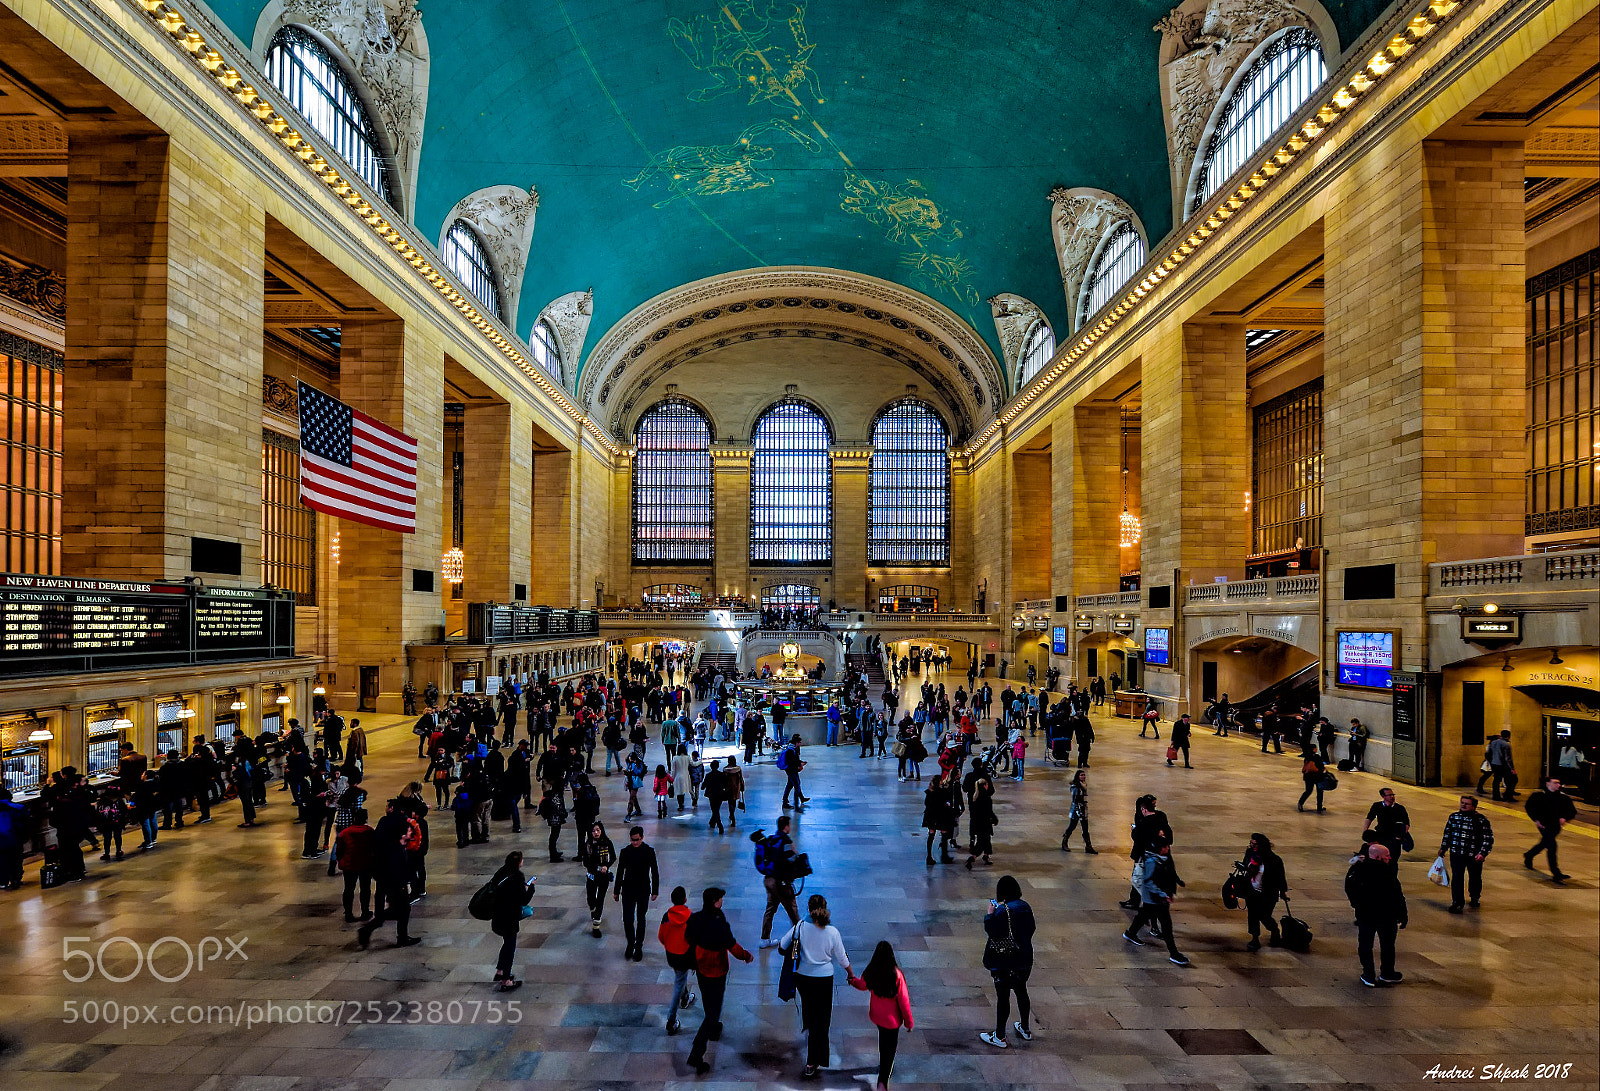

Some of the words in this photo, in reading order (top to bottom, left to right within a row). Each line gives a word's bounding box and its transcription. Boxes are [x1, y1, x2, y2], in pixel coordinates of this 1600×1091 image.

[6, 576, 33, 586] NEW
[36, 578, 72, 588] HAVEN
[74, 580, 96, 589] LINE
[98, 582, 151, 592] DEPARTURES
[9, 593, 65, 601] DESTINATION
[210, 588, 254, 597] INFORMATION
[1541, 673, 1580, 682] TRACKS
